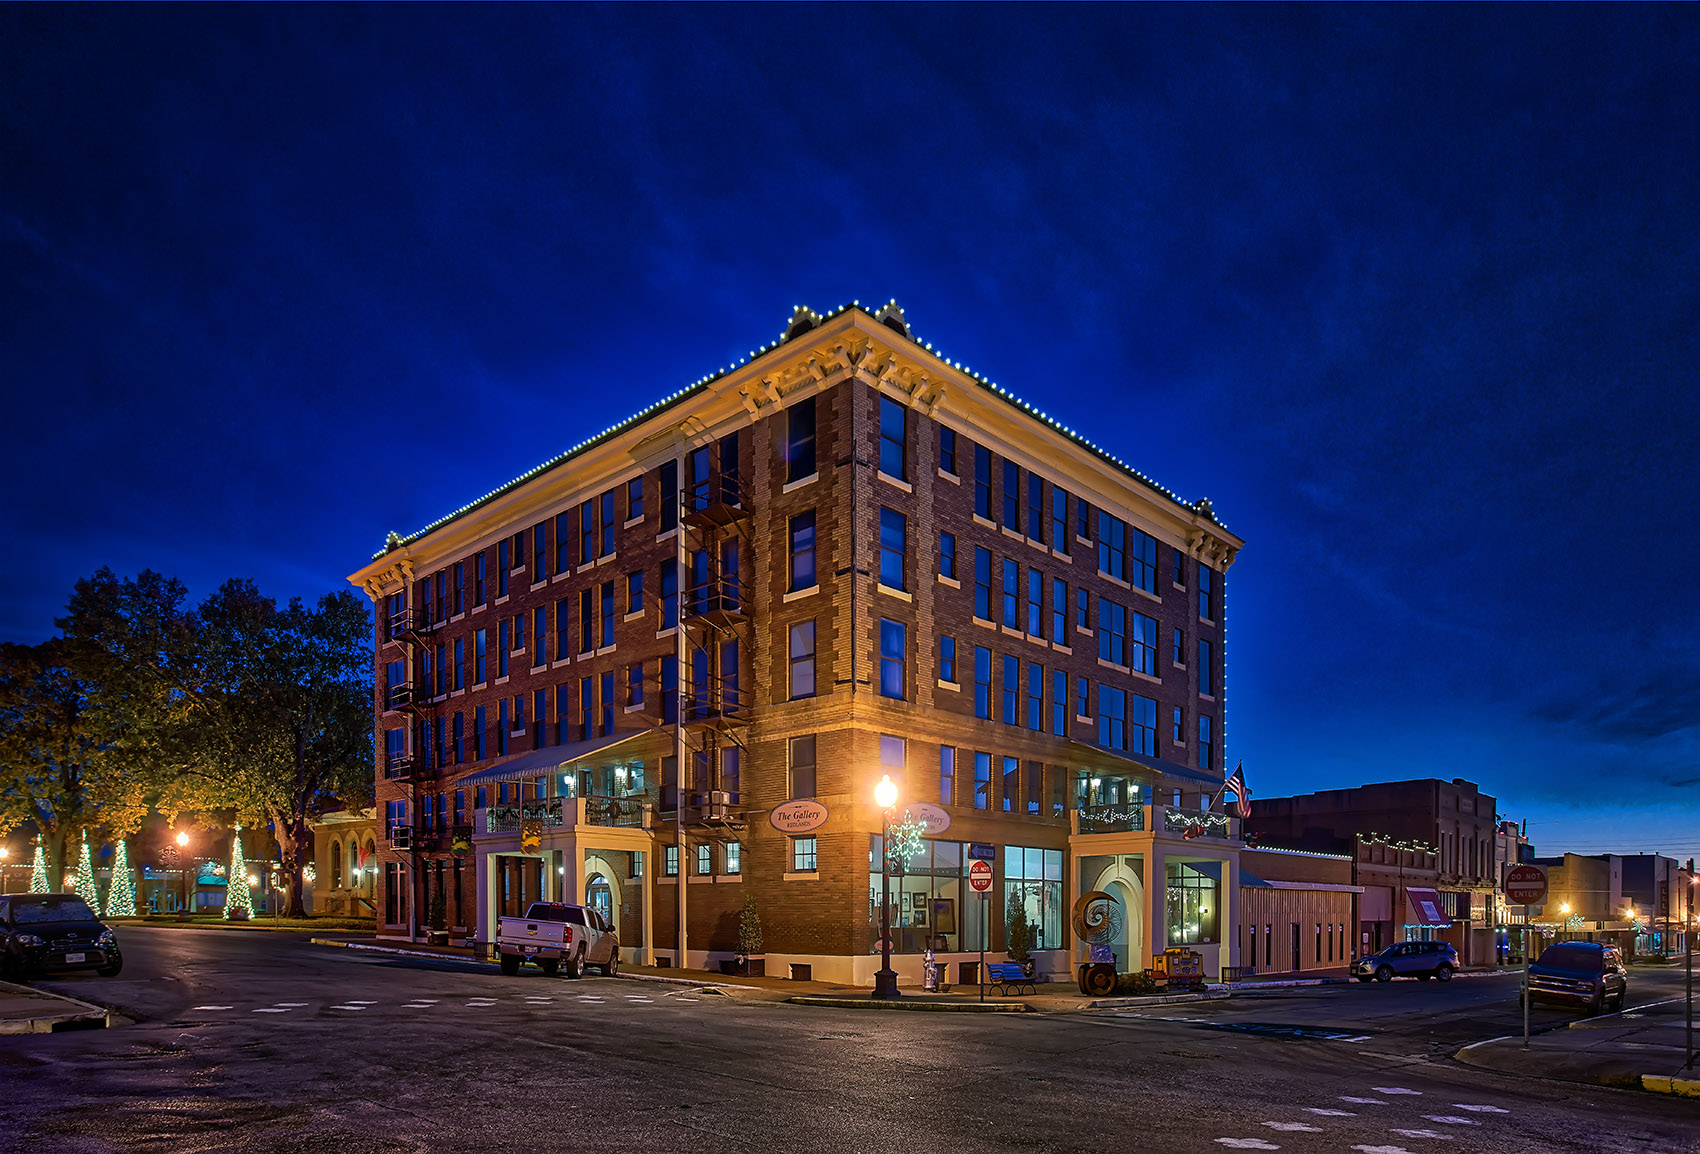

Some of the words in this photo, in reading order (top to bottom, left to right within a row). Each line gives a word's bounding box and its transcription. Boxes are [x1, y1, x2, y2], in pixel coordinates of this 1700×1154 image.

[777, 811, 791, 821] The
[793, 810, 821, 820] Gallery
[920, 813, 944, 825] Gallery
[1525, 872, 1540, 880] NOT
[1514, 890, 1538, 898] ENTER
